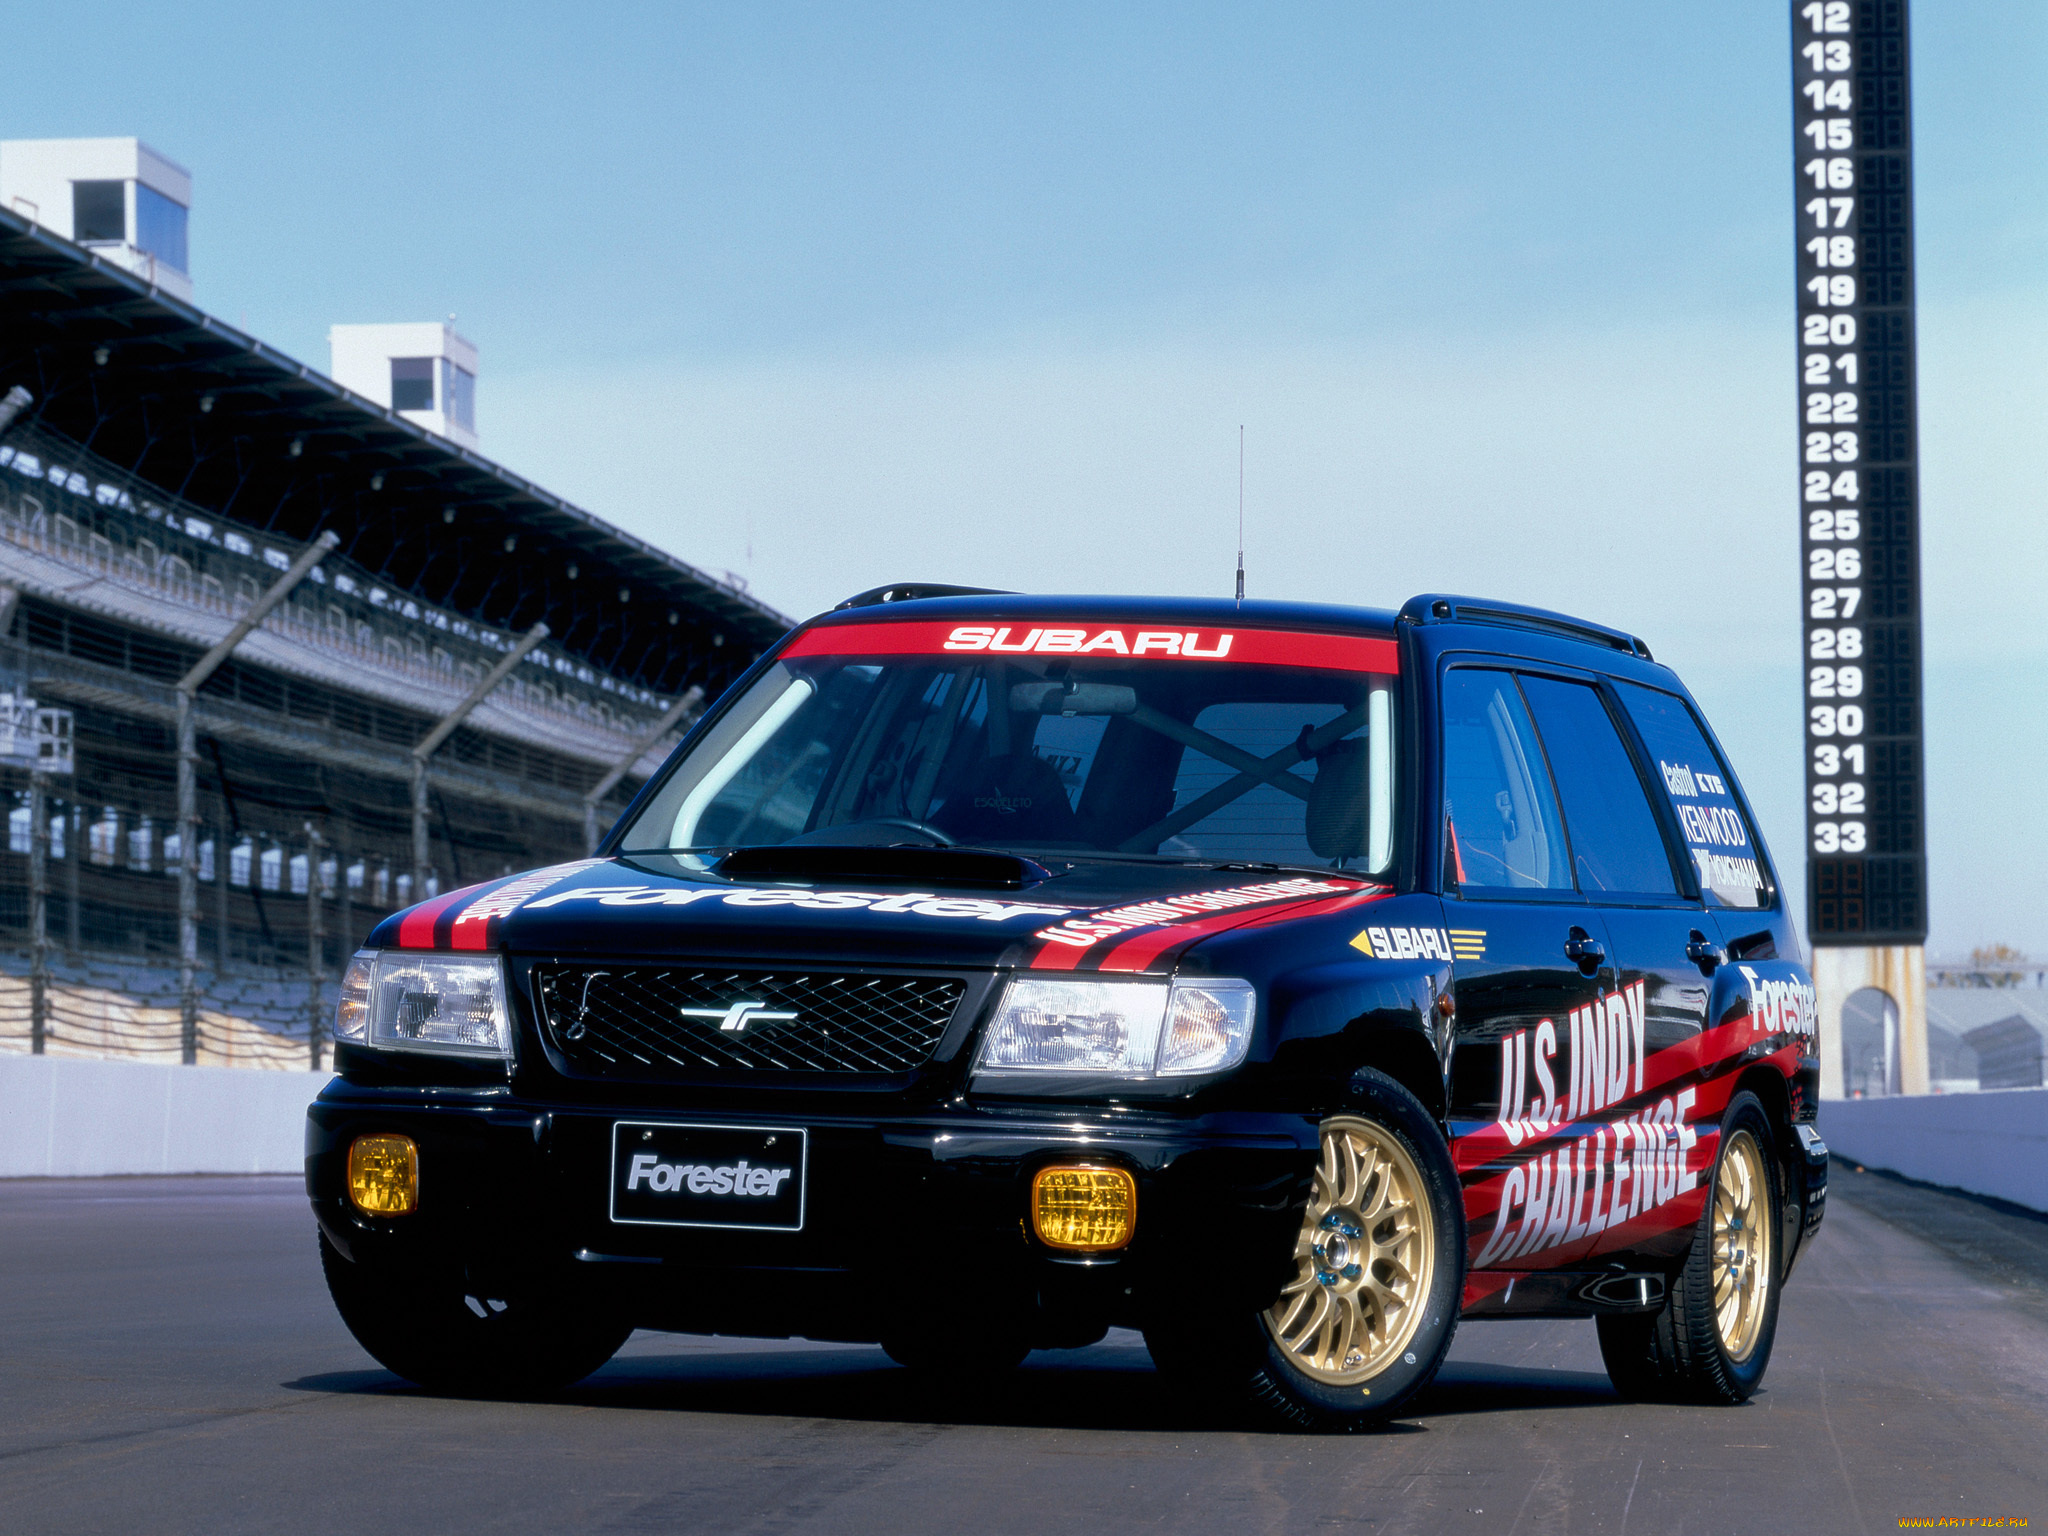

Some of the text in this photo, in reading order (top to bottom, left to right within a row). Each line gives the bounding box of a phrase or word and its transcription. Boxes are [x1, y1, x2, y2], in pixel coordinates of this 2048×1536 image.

[1802, 1, 1850, 32] 12
[1803, 40, 1851, 72] 13
[1804, 80, 1852, 110] 14
[1804, 119, 1852, 150] 15
[1805, 158, 1853, 189] 16
[1806, 197, 1853, 228] 17
[1806, 236, 1855, 267] 18
[1807, 275, 1855, 306] 19
[1804, 314, 1856, 345] 20
[1805, 353, 1857, 384] 21
[1807, 392, 1858, 423] 22
[1806, 431, 1858, 463] 23
[1806, 470, 1859, 501] 24
[1809, 510, 1860, 540] 25
[1810, 548, 1861, 579] 26
[1811, 588, 1861, 618] 27
[943, 627, 1233, 657] SUBARU
[1811, 627, 1862, 659] 28
[1810, 666, 1862, 697] 29
[1811, 705, 1863, 736] 30
[1814, 744, 1864, 775] 31
[1661, 760, 1725, 797] Castrol KYB
[1813, 782, 1865, 814] 32
[1677, 805, 1746, 846] KENWOOD
[1814, 822, 1866, 853] 33
[1709, 854, 1764, 889] YOKOHAMA
[523, 886, 1070, 921] Forester
[1167, 878, 1349, 910] CHALLENGE
[1368, 927, 1452, 960] SUBARU
[1739, 966, 1815, 1038] Forester
[627, 1154, 791, 1196] Forester
[1473, 1085, 1697, 1268] CHALLENGE
